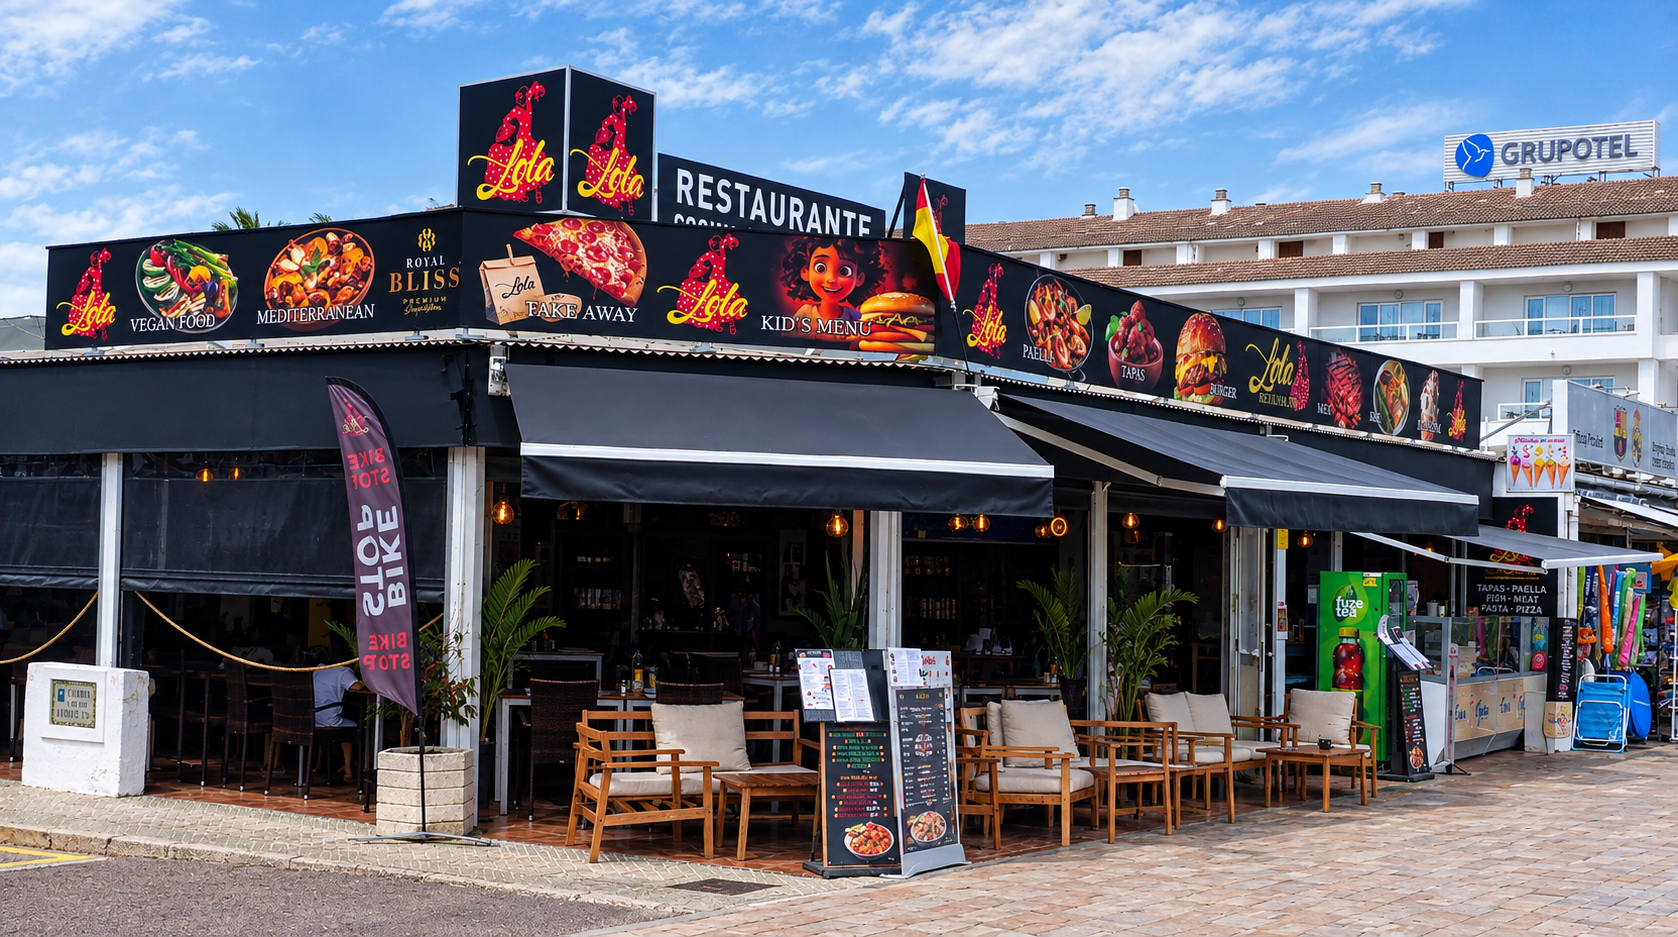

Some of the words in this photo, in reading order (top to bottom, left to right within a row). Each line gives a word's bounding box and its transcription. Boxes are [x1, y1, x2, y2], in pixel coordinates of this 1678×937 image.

[1500, 134, 1638, 165] GRUPOTEL
[467, 138, 555, 200] Lola
[569, 147, 645, 199] Lola
[676, 167, 872, 237] RESTAURANTE
[406, 255, 445, 269] ROYAL
[388, 266, 460, 293] BLISS
[494, 275, 536, 299] Lola
[657, 279, 749, 325] Lola
[56, 290, 117, 336] Lola
[130, 317, 175, 332] VEGAN
[179, 313, 215, 329] FOOD
[256, 304, 375, 324] MEDITERRANEAN
[582, 305, 638, 322] AWAY
[761, 314, 812, 334] KID'S
[816, 318, 872, 336] MENU
[962, 304, 1008, 347] Lola
[1022, 343, 1056, 363] PAELLA
[1121, 365, 1146, 382] TAPAS
[1245, 337, 1295, 393] Lola
[1209, 382, 1237, 399] BURGER
[1476, 583, 1505, 593] TAPAS
[1511, 584, 1547, 594] PAELLA
[1335, 595, 1364, 609] fuze
[1335, 606, 1357, 617] tea
[1515, 605, 1542, 614] PIZZA
